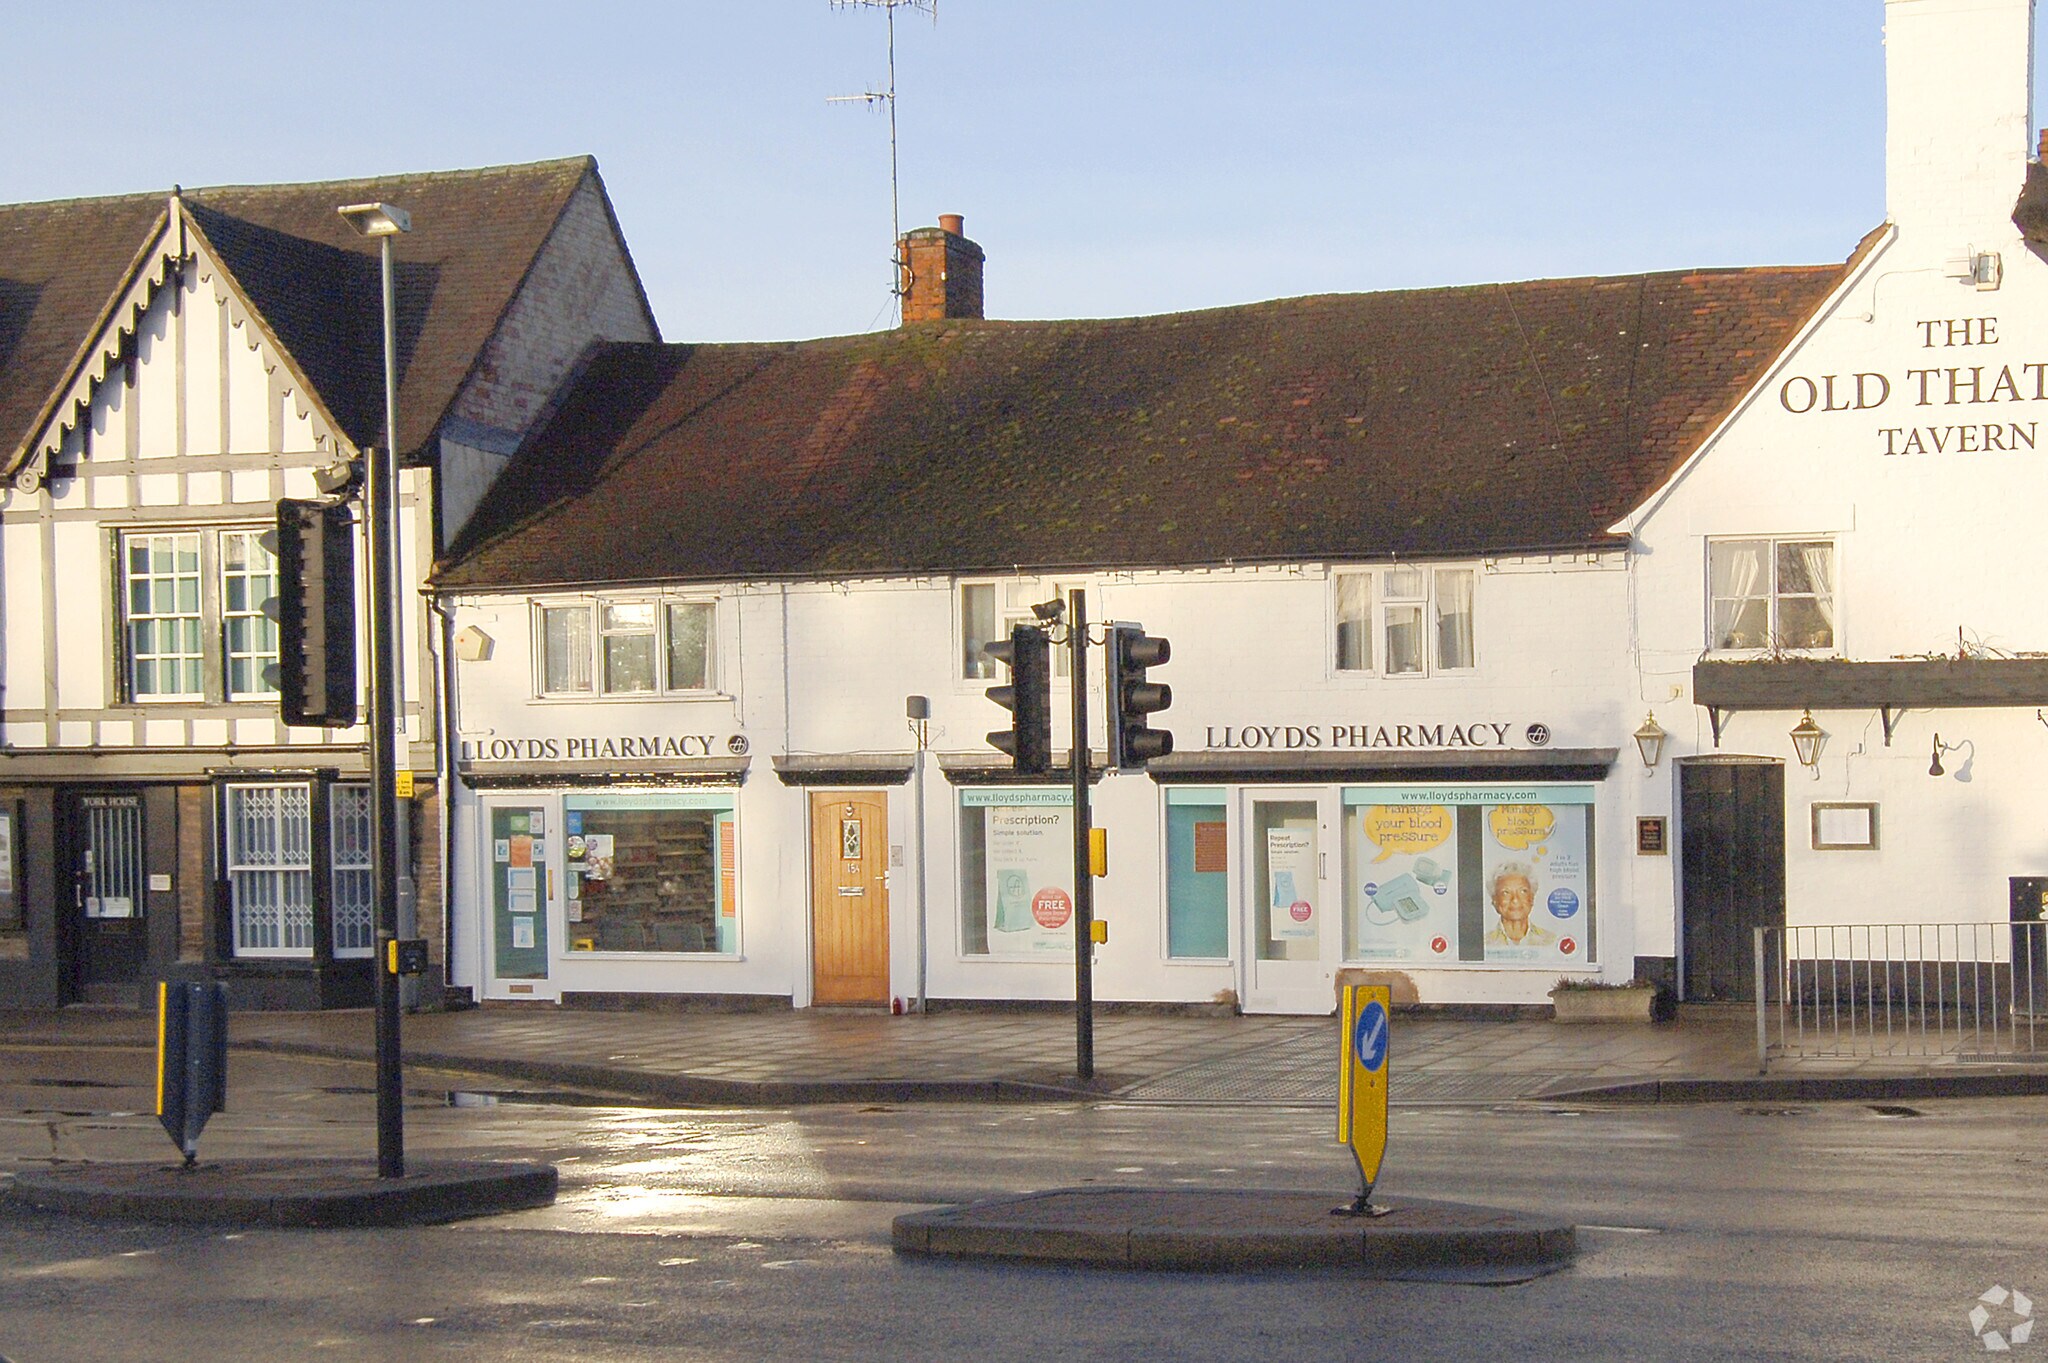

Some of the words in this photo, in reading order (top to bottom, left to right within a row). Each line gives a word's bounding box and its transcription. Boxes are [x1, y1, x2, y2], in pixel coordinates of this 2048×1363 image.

[1917, 317, 1999, 348] THE
[1780, 373, 1890, 414] OLD
[1907, 363, 2048, 406] THAT
[1878, 422, 2039, 456] TAVERN
[1205, 725, 1322, 749] LLOYDS
[1331, 723, 1512, 748] PHARMACY
[462, 738, 559, 760] LLOYDS
[567, 735, 715, 757] PHARMACY
[83, 796, 107, 806] YORK
[110, 796, 138, 806] HOUSE
[595, 796, 707, 807] www.lloydspharmacy.com
[967, 793, 1074, 803] www.lloydspharmacy.c
[1401, 791, 1537, 802] www.lloydspharmacy.com
[993, 814, 1060, 826] Prescription?
[1376, 820, 1404, 831] your
[1409, 817, 1442, 829] blood
[1507, 816, 1535, 826] blood
[1380, 832, 1438, 845] pressure
[1038, 900, 1066, 910] FREE
